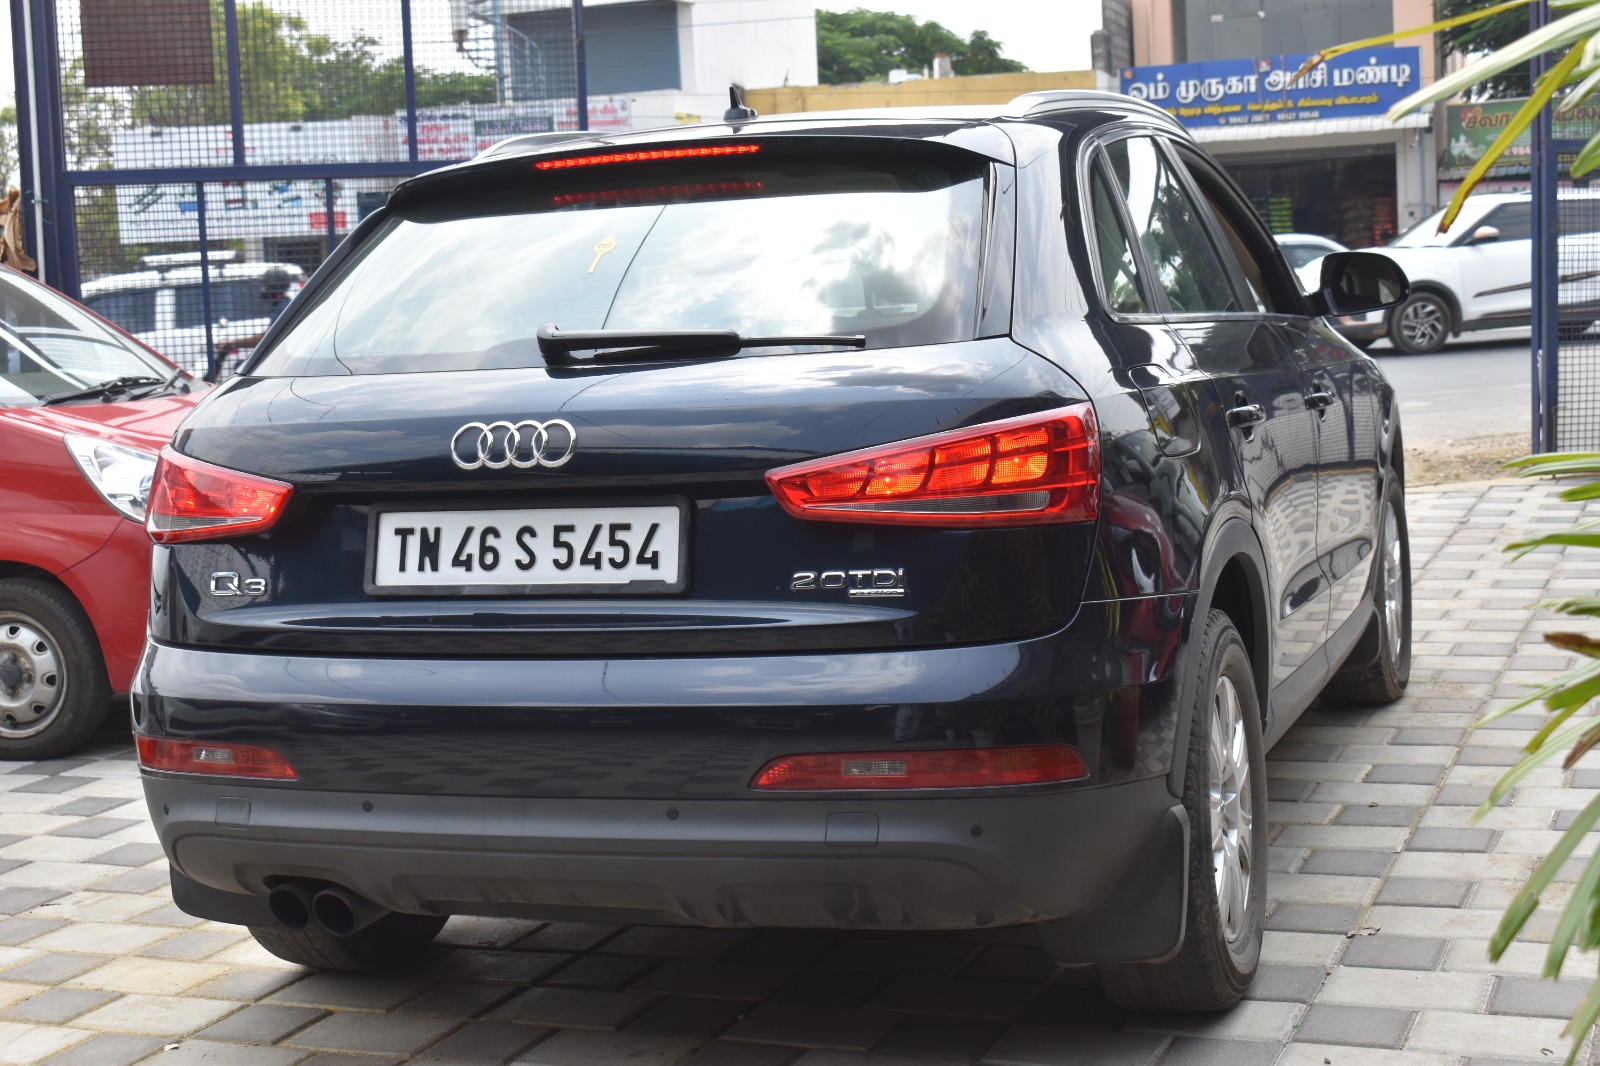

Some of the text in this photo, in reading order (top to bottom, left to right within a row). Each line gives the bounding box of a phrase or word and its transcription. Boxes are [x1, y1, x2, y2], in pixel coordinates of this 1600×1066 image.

[1176, 74, 1259, 103] முருகா
[1333, 56, 1411, 87] மண்டி
[394, 522, 660, 572] TN 46 S 5454
[210, 571, 267, 596] Q3
